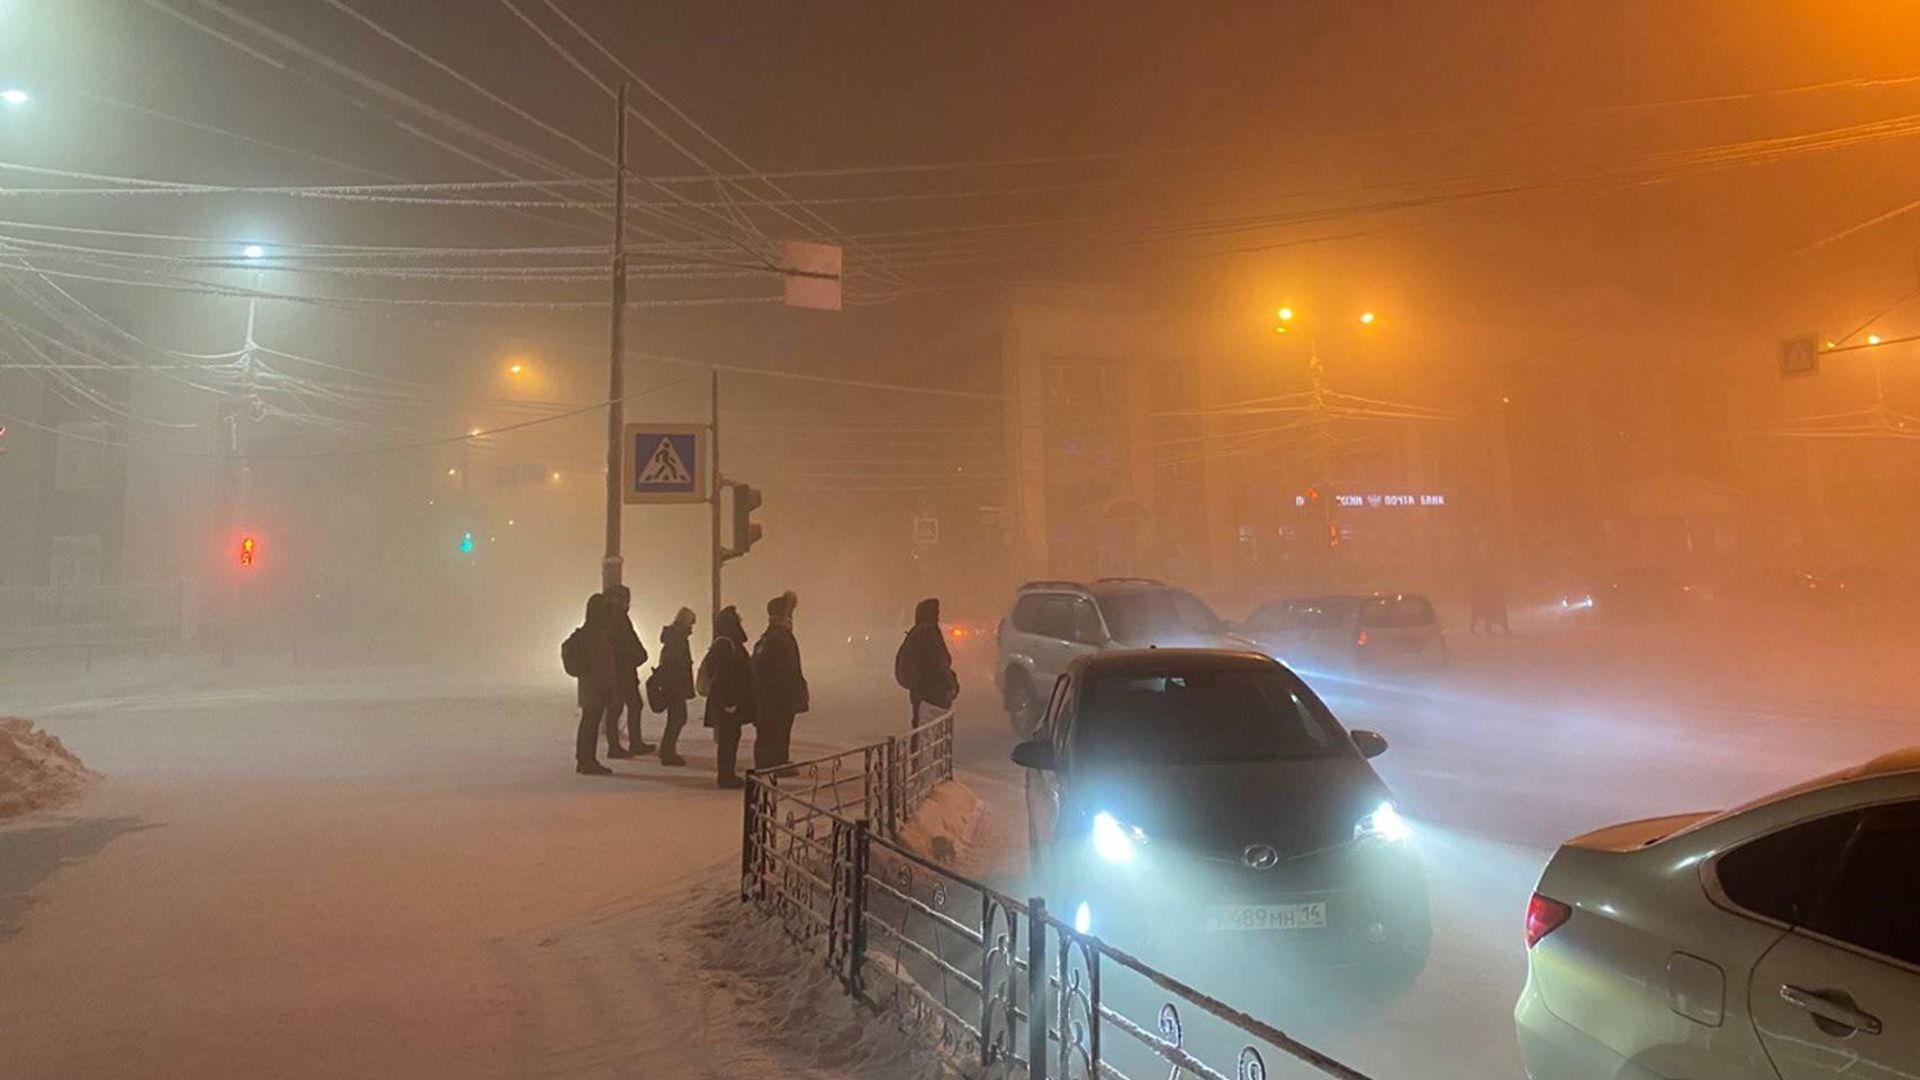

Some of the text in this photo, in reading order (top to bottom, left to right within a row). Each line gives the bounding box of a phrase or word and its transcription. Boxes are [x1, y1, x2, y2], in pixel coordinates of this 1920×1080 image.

[1384, 495, 1415, 506] ПОЧТА
[1420, 495, 1445, 506] БАНК
[1302, 904, 1321, 921] 14
